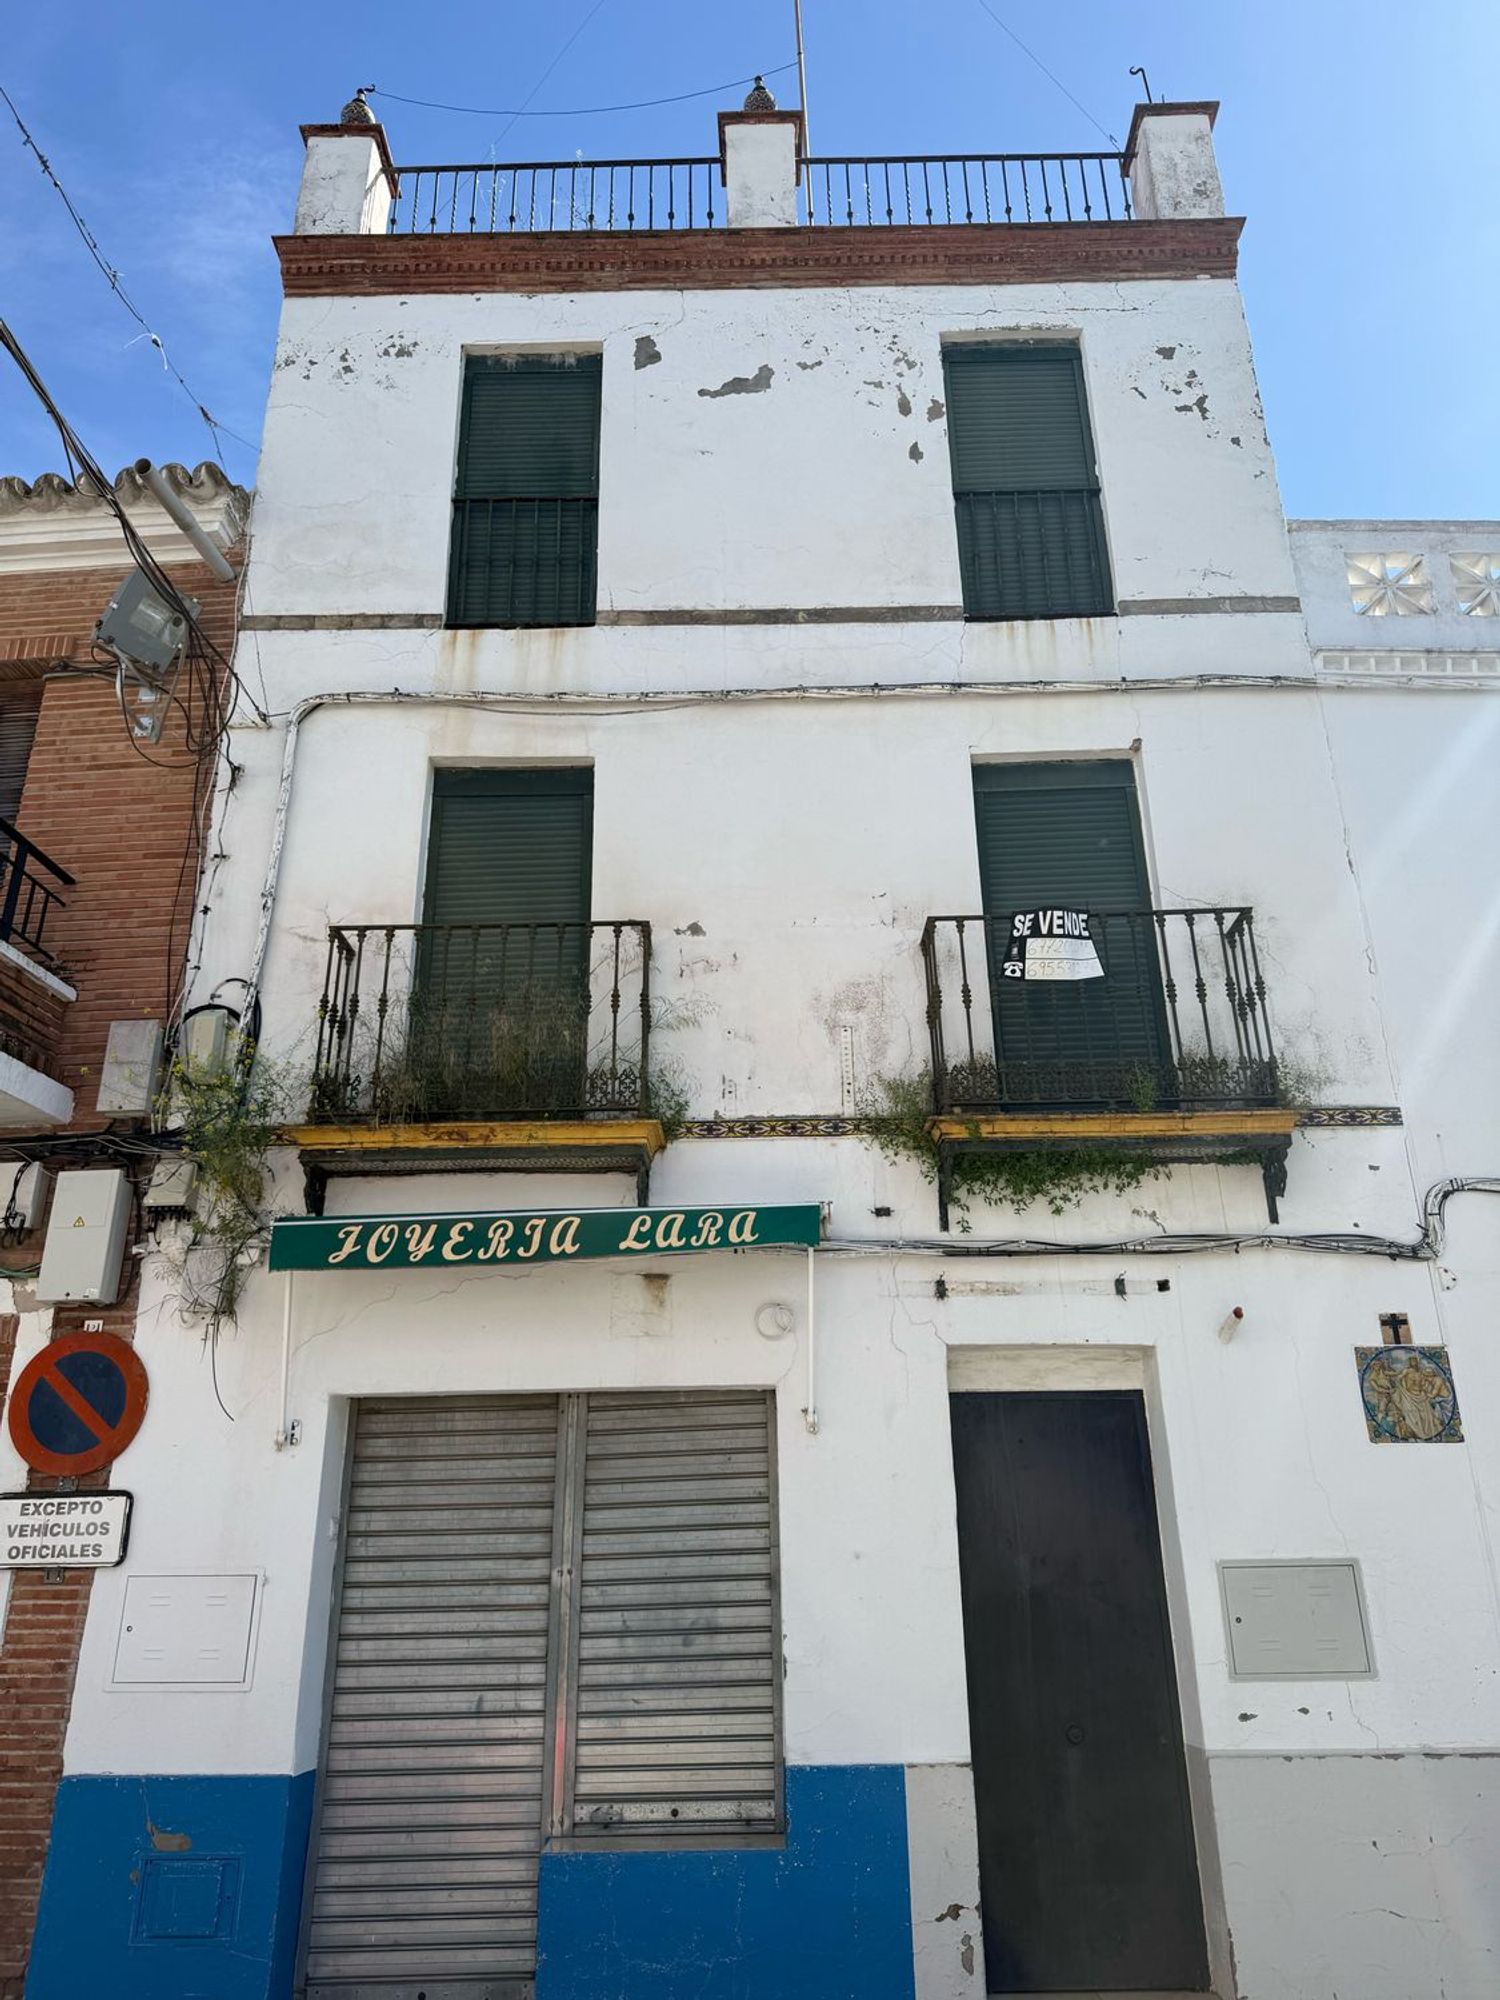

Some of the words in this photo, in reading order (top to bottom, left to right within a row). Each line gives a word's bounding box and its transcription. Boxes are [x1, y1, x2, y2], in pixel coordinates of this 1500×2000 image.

[1012, 914, 1035, 937] SE
[1038, 910, 1090, 937] VENDE
[328, 1216, 581, 1264] JOYERIA
[618, 1211, 759, 1250] LARA
[19, 1500, 103, 1517] EXCEPTO
[7, 1519, 110, 1538] VEHÍCULOS
[7, 1543, 103, 1560] OFICIALES
